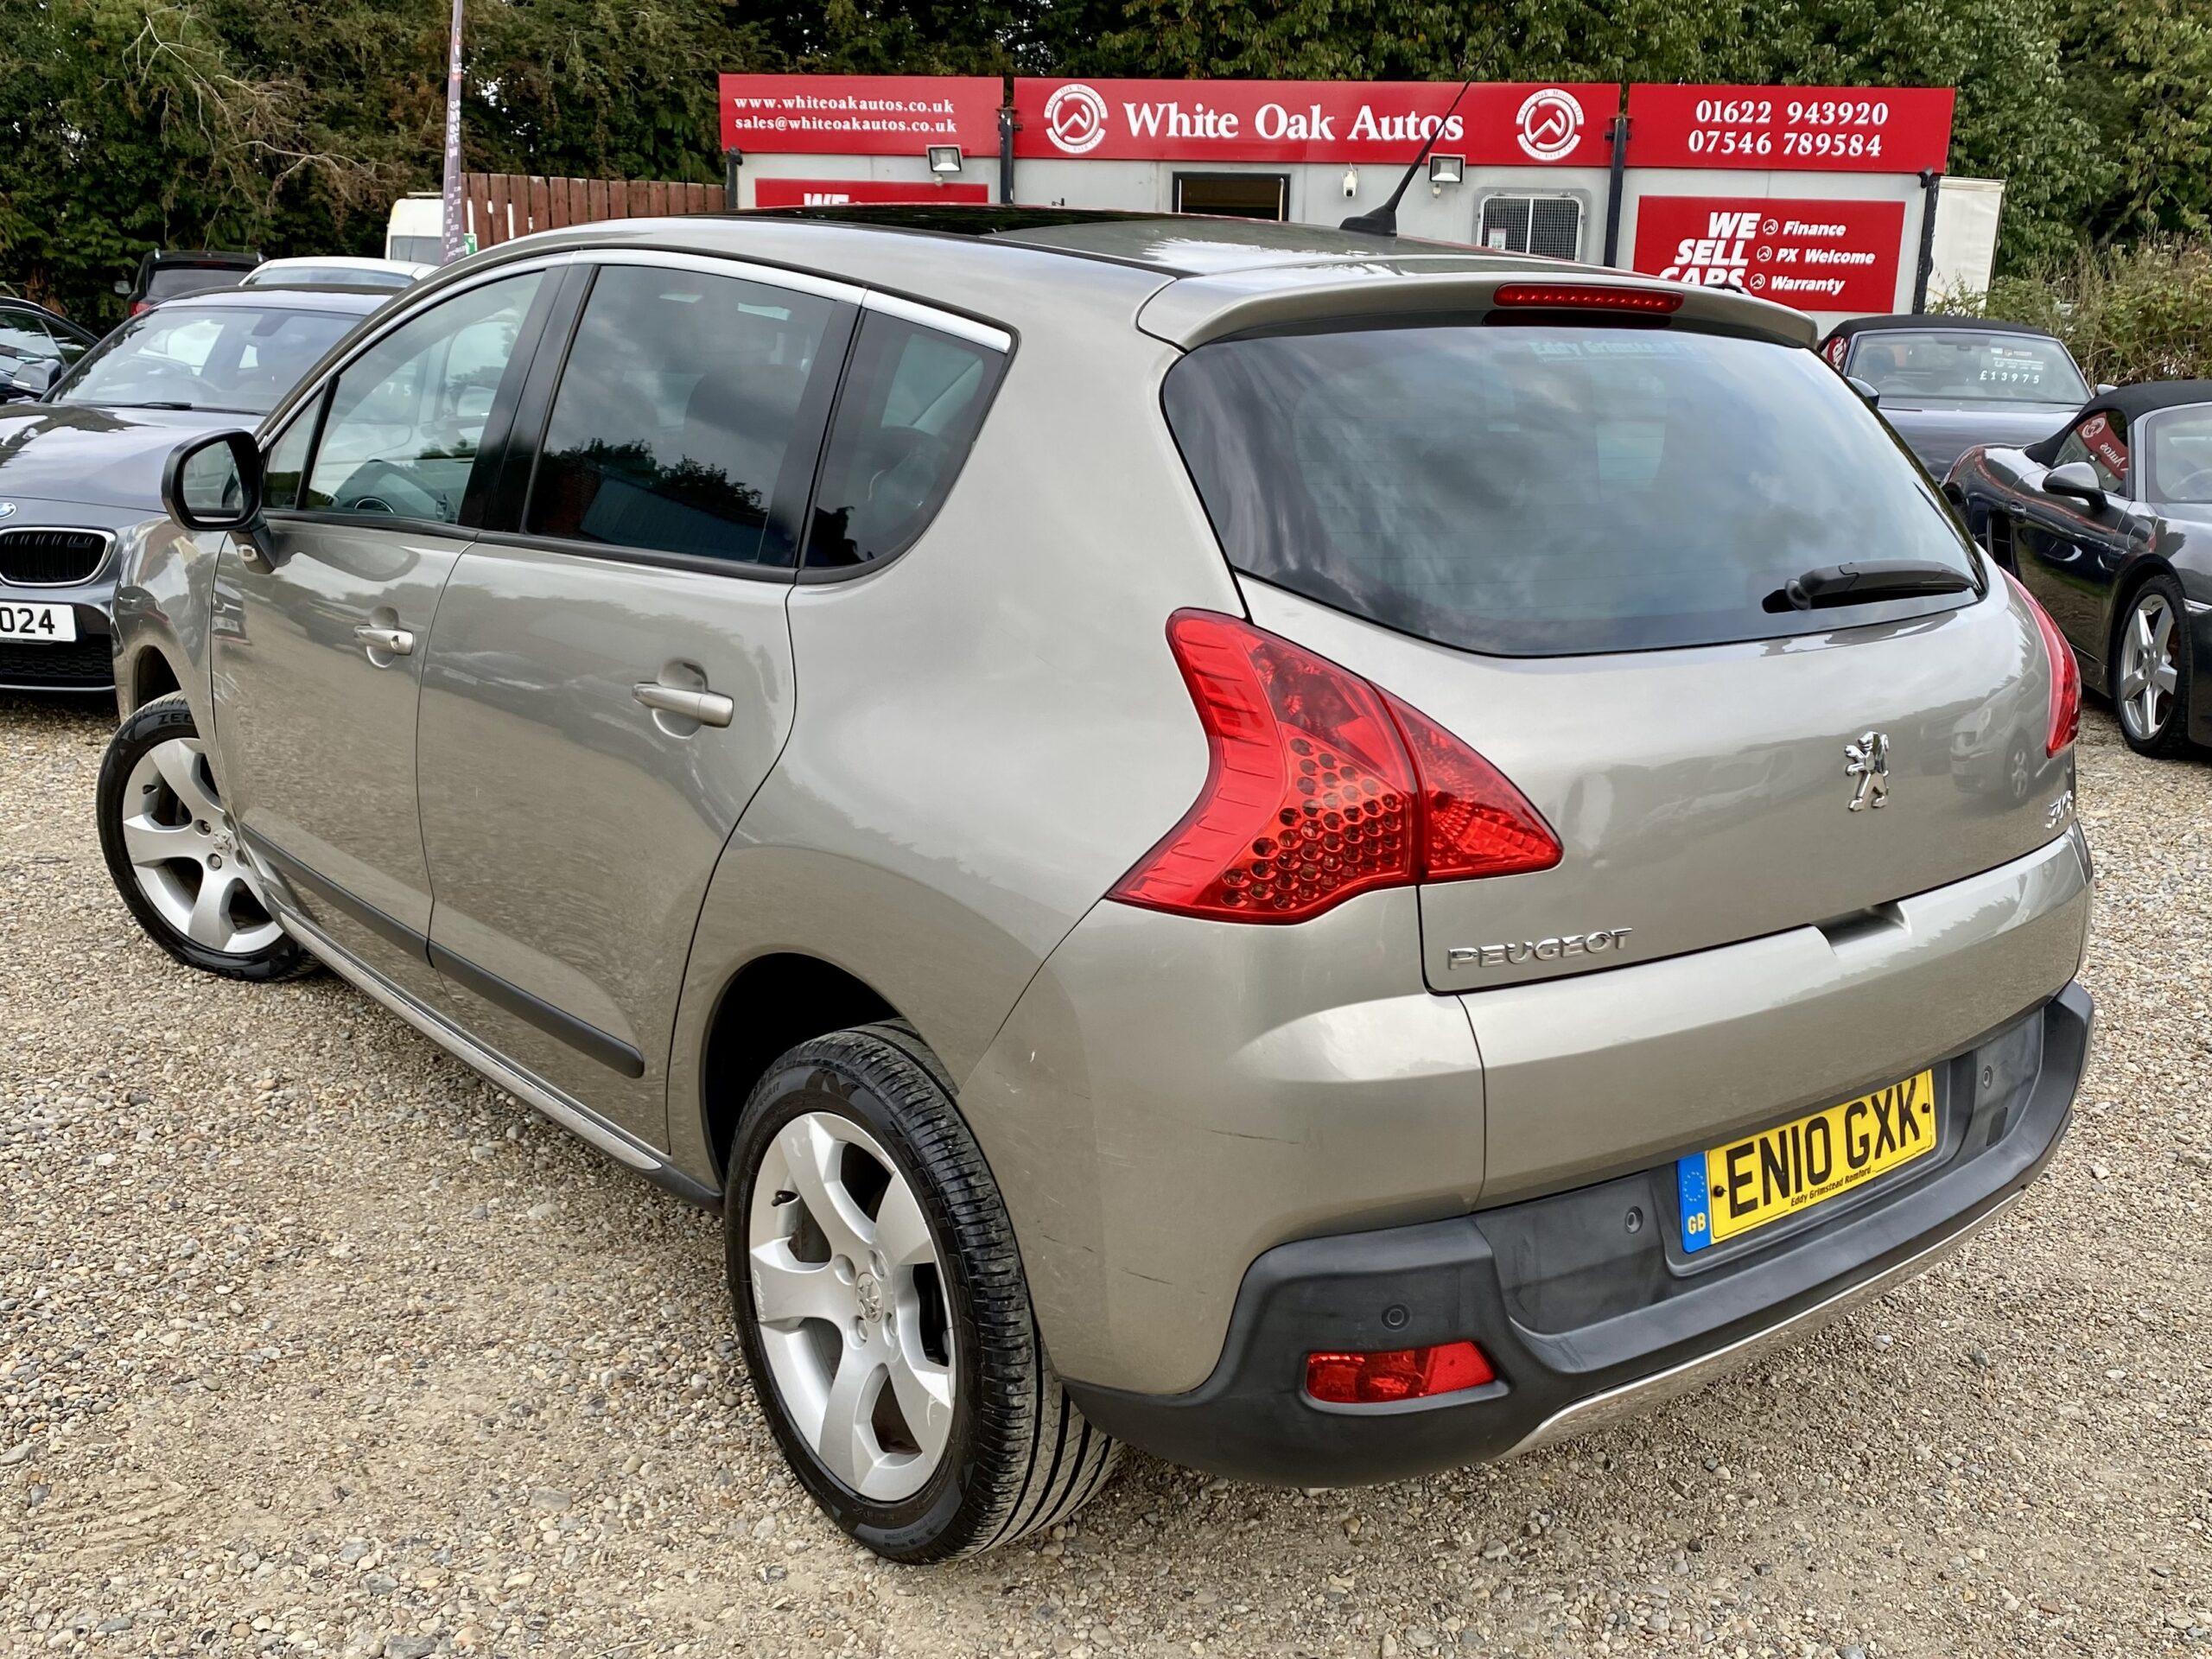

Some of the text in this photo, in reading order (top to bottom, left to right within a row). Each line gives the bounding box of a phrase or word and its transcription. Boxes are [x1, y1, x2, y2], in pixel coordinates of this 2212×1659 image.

[734, 95, 954, 113] www.whiteoakautos.co.uk
[1695, 99, 1889, 125] 01622 943920
[734, 116, 957, 133] sales@whiteoakautos.co.uk
[1123, 102, 1465, 141] White Oak Autos
[1688, 130, 1882, 157] 07546 789584
[1707, 212, 1762, 239] WE
[1783, 220, 1847, 237] Finance
[1674, 239, 1750, 267] SELL
[1776, 248, 1876, 265] PX Welcome
[1770, 276, 1846, 296] Warranty
[1448, 927, 1634, 970] PEUGEOT
[1726, 1077, 1920, 1219] EN10 GXK
[1790, 1192, 1808, 1207] Eddy
[1808, 1176, 1844, 1199] Grimstead
[1688, 1212, 1707, 1235] GB
